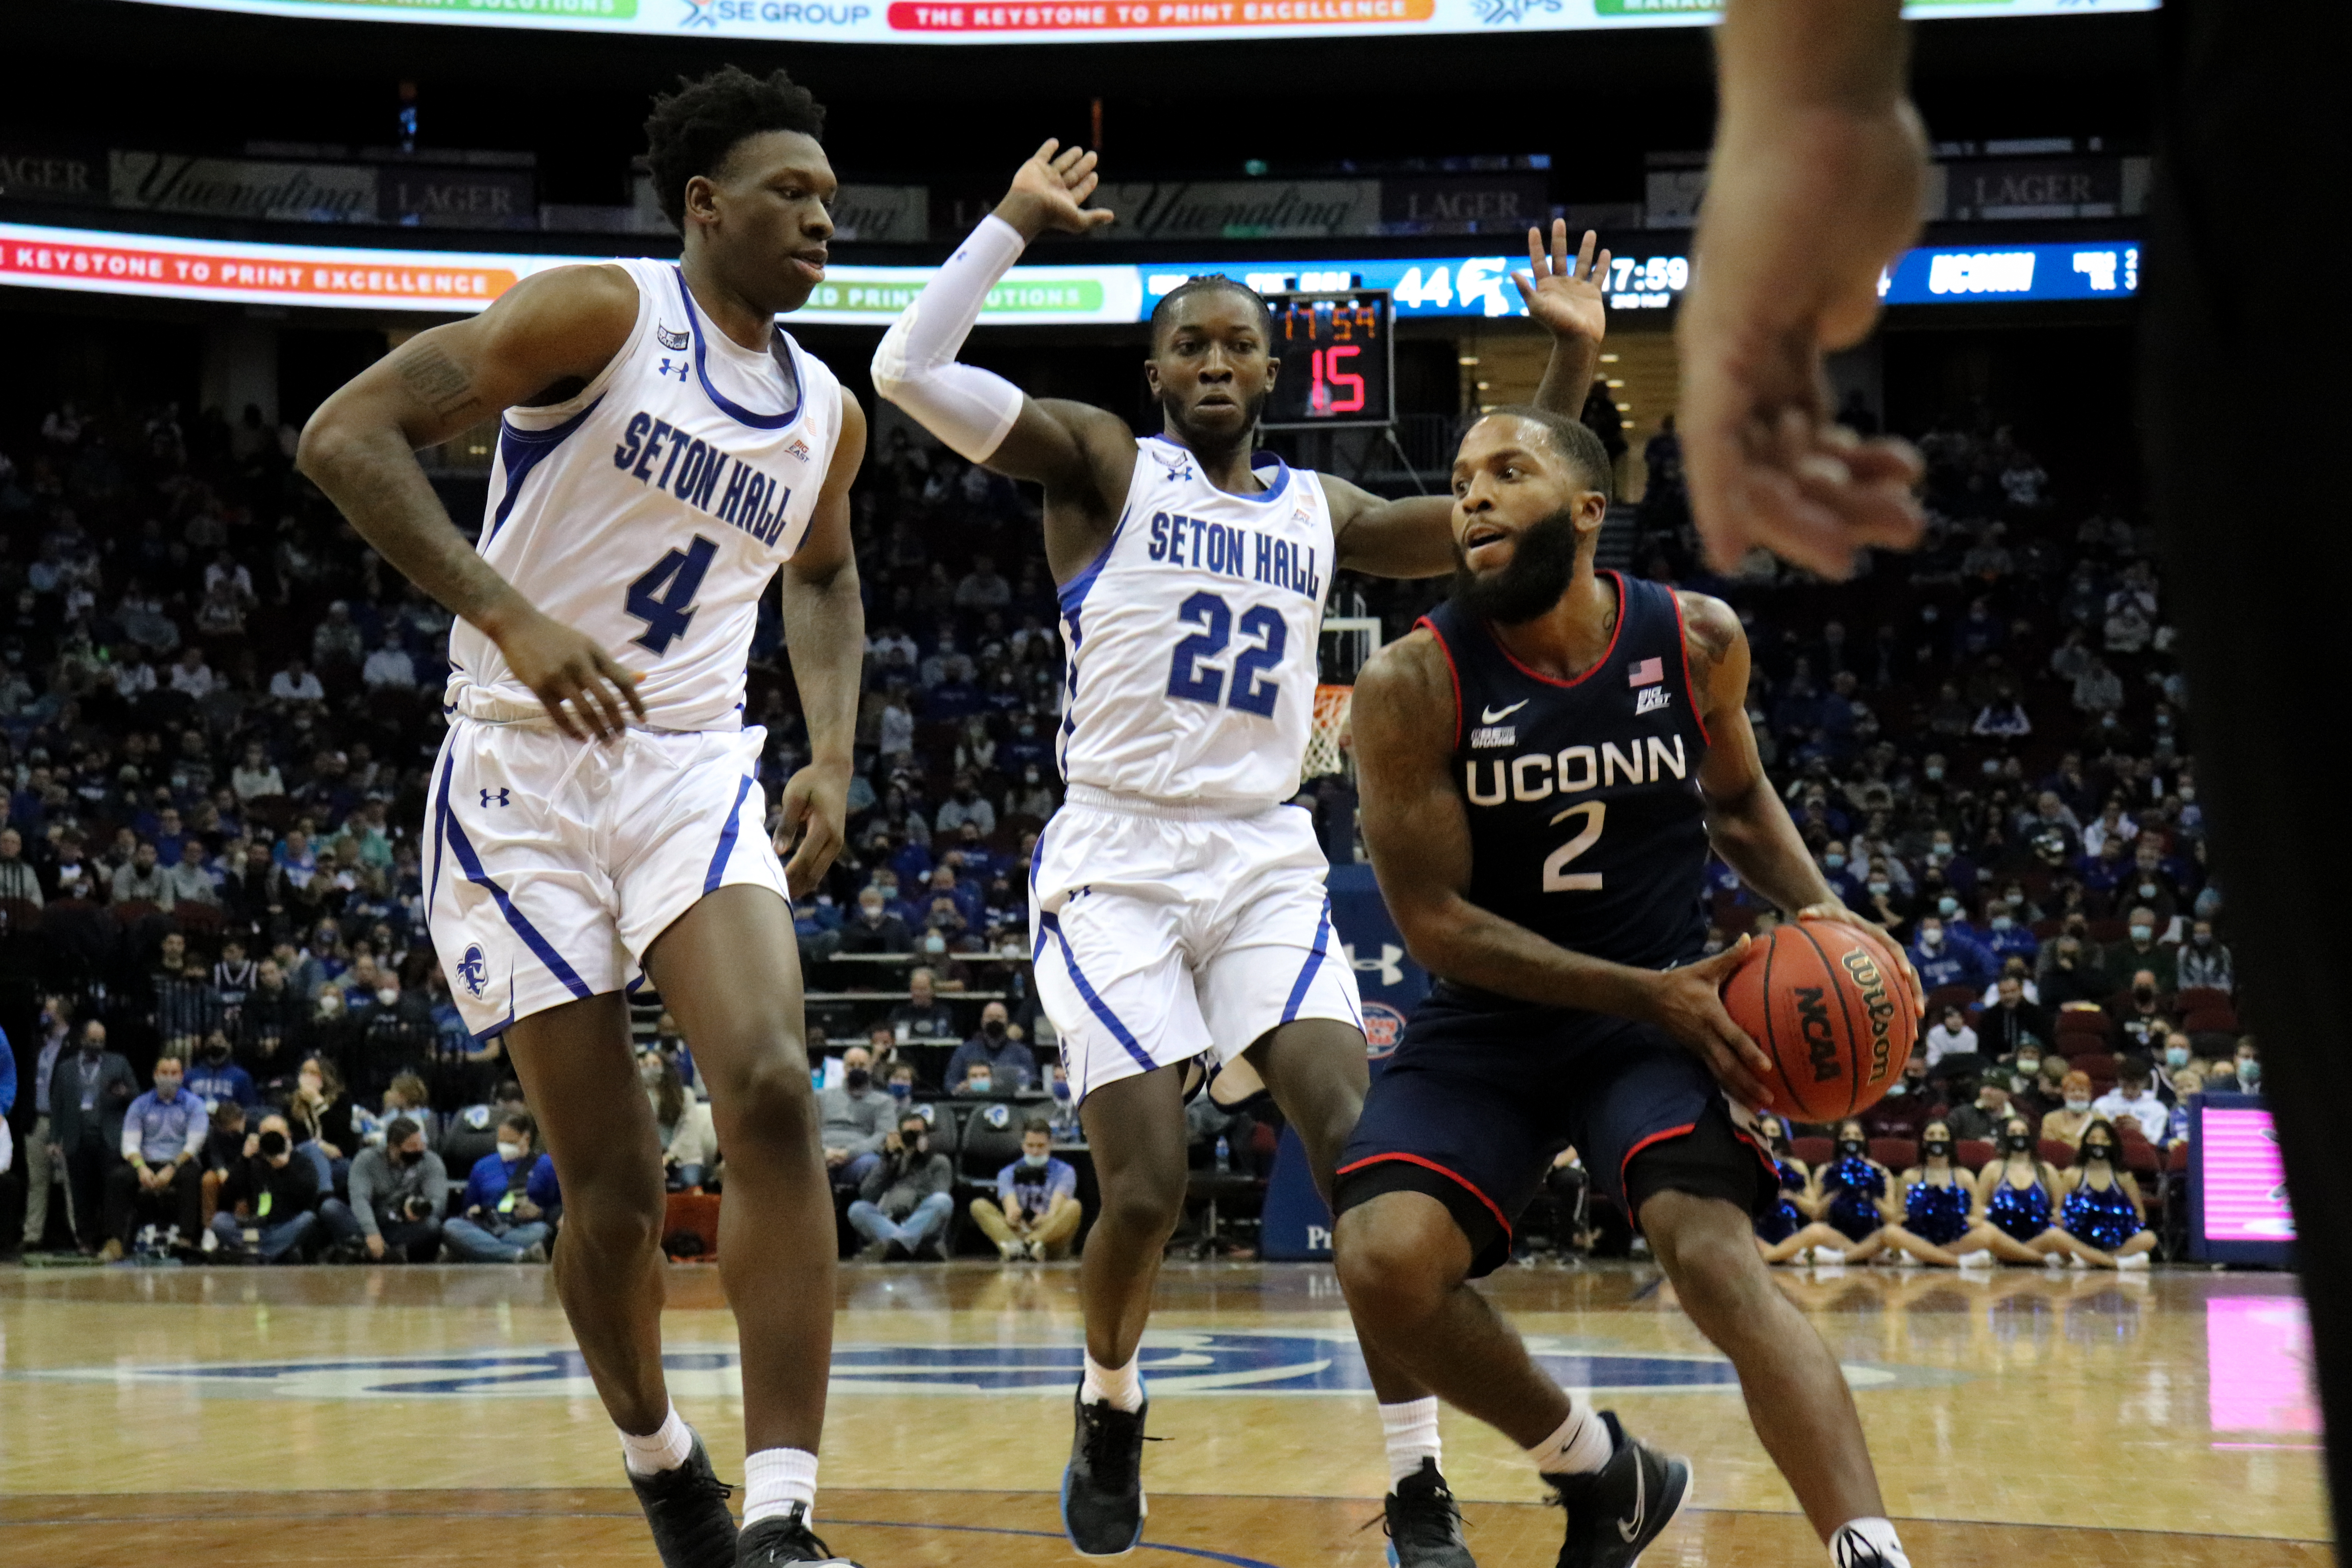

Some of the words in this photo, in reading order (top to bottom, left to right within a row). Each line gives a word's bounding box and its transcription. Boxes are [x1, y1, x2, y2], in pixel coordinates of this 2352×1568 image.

[718, 1, 756, 21] SE
[761, 3, 872, 25] GROUP
[916, 8, 965, 26] THE
[973, 7, 1106, 26] KEYSTONE
[1117, 6, 1150, 24] TO
[1158, 4, 1233, 22] PRINT
[1243, 1, 1405, 21] EXCELLENCE
[399, 182, 512, 214] LAGER
[1408, 191, 1520, 220] LAGER
[1975, 174, 2092, 204] LAGER
[17, 247, 163, 278] KEYSTONE
[175, 260, 211, 281] TO
[221, 263, 303, 287] PRINT
[313, 269, 487, 295] EXCELLENCE
[1393, 266, 1453, 308] 44
[1312, 345, 1365, 412] 15
[789, 445, 810, 463] EAST
[794, 439, 809, 453] BIG
[613, 411, 730, 512] SETON
[717, 458, 792, 549] HALL
[1148, 511, 1246, 578] SETON
[1255, 531, 1320, 603] HALL
[623, 533, 720, 659] 4
[1165, 590, 1289, 720] 22
[1466, 733, 1686, 806] UCONN
[1542, 800, 1606, 893] 2
[1795, 987, 1842, 1083] NCAA
[1841, 945, 1894, 1086] Wilson
